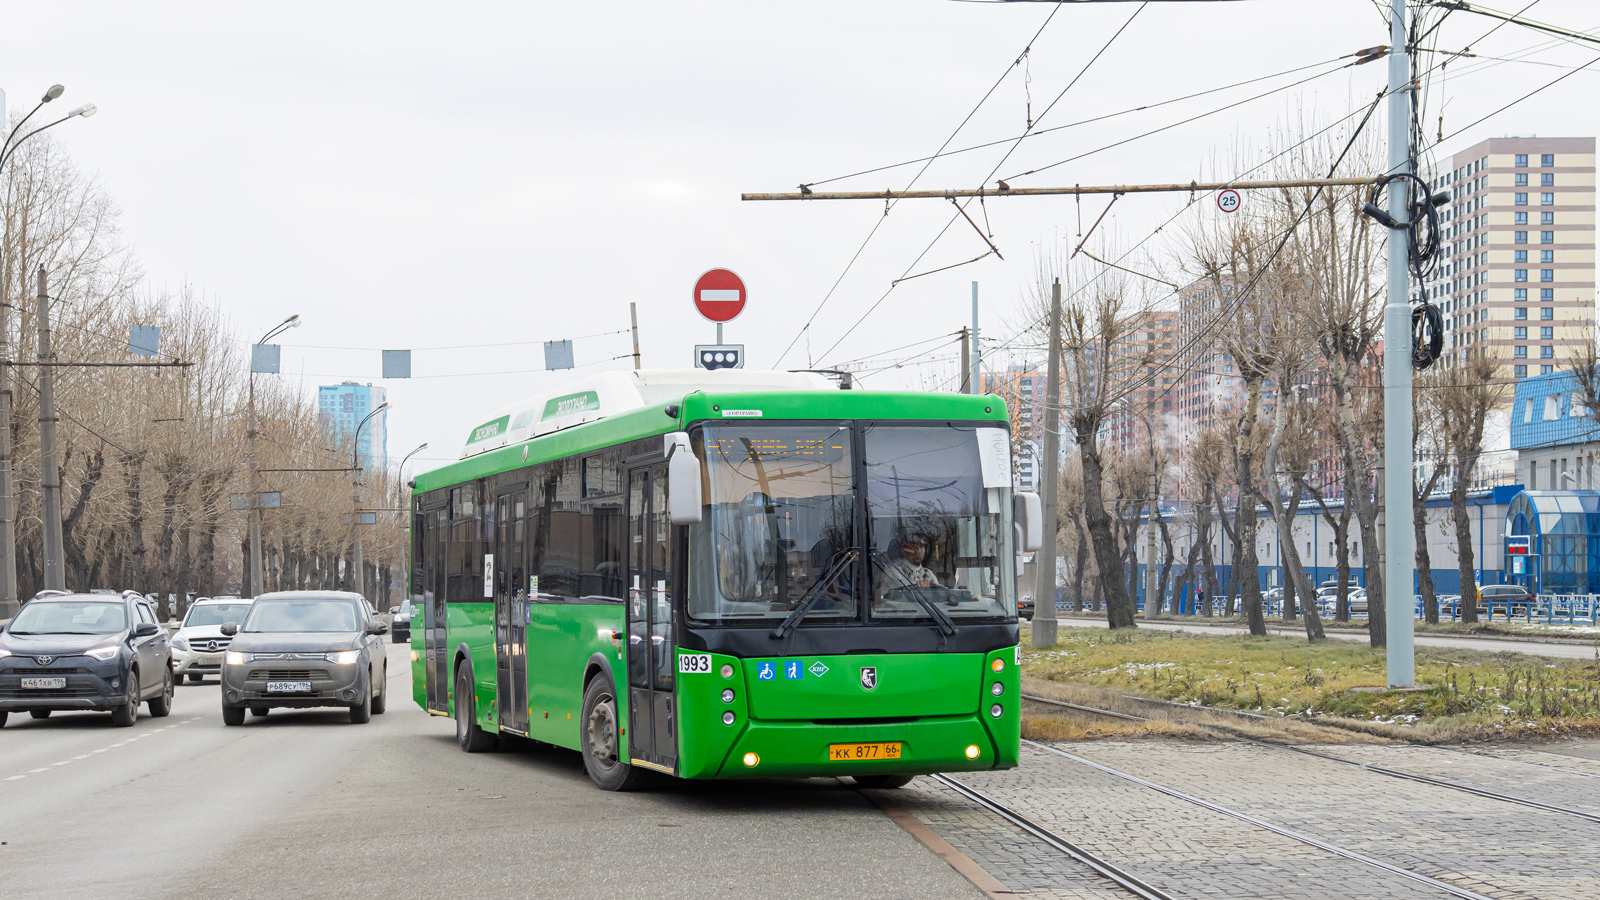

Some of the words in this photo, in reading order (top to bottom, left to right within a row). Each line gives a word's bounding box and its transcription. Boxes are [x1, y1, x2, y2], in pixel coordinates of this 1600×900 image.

[1222, 196, 1236, 206] 25
[679, 655, 709, 671] 1993
[856, 745, 878, 758] 877
[885, 744, 897, 754] 66
